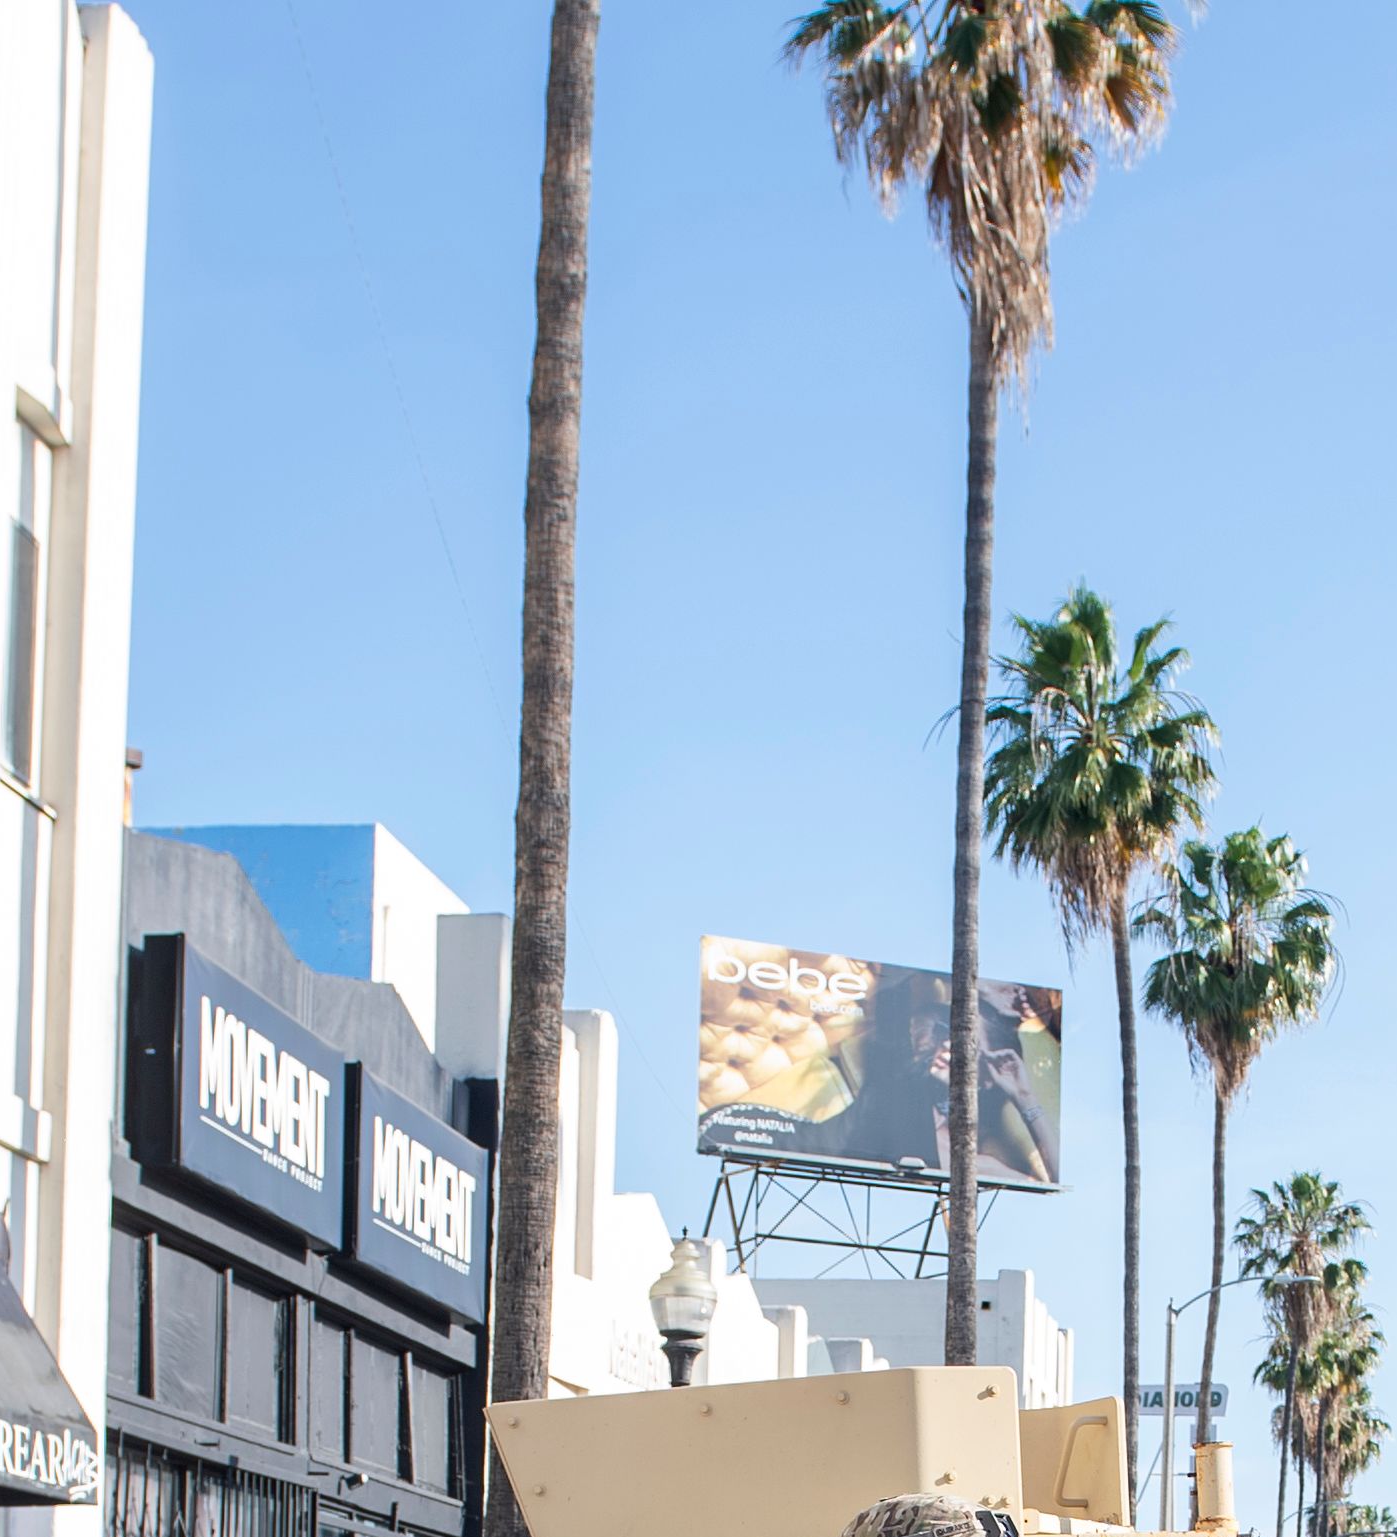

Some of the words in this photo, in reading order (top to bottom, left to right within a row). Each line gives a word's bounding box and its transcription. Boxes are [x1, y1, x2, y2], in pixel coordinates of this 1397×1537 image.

[707, 946, 868, 1000] bebe
[200, 995, 330, 1179] MOVEMENT
[372, 1115, 476, 1264] MOVEMENT
